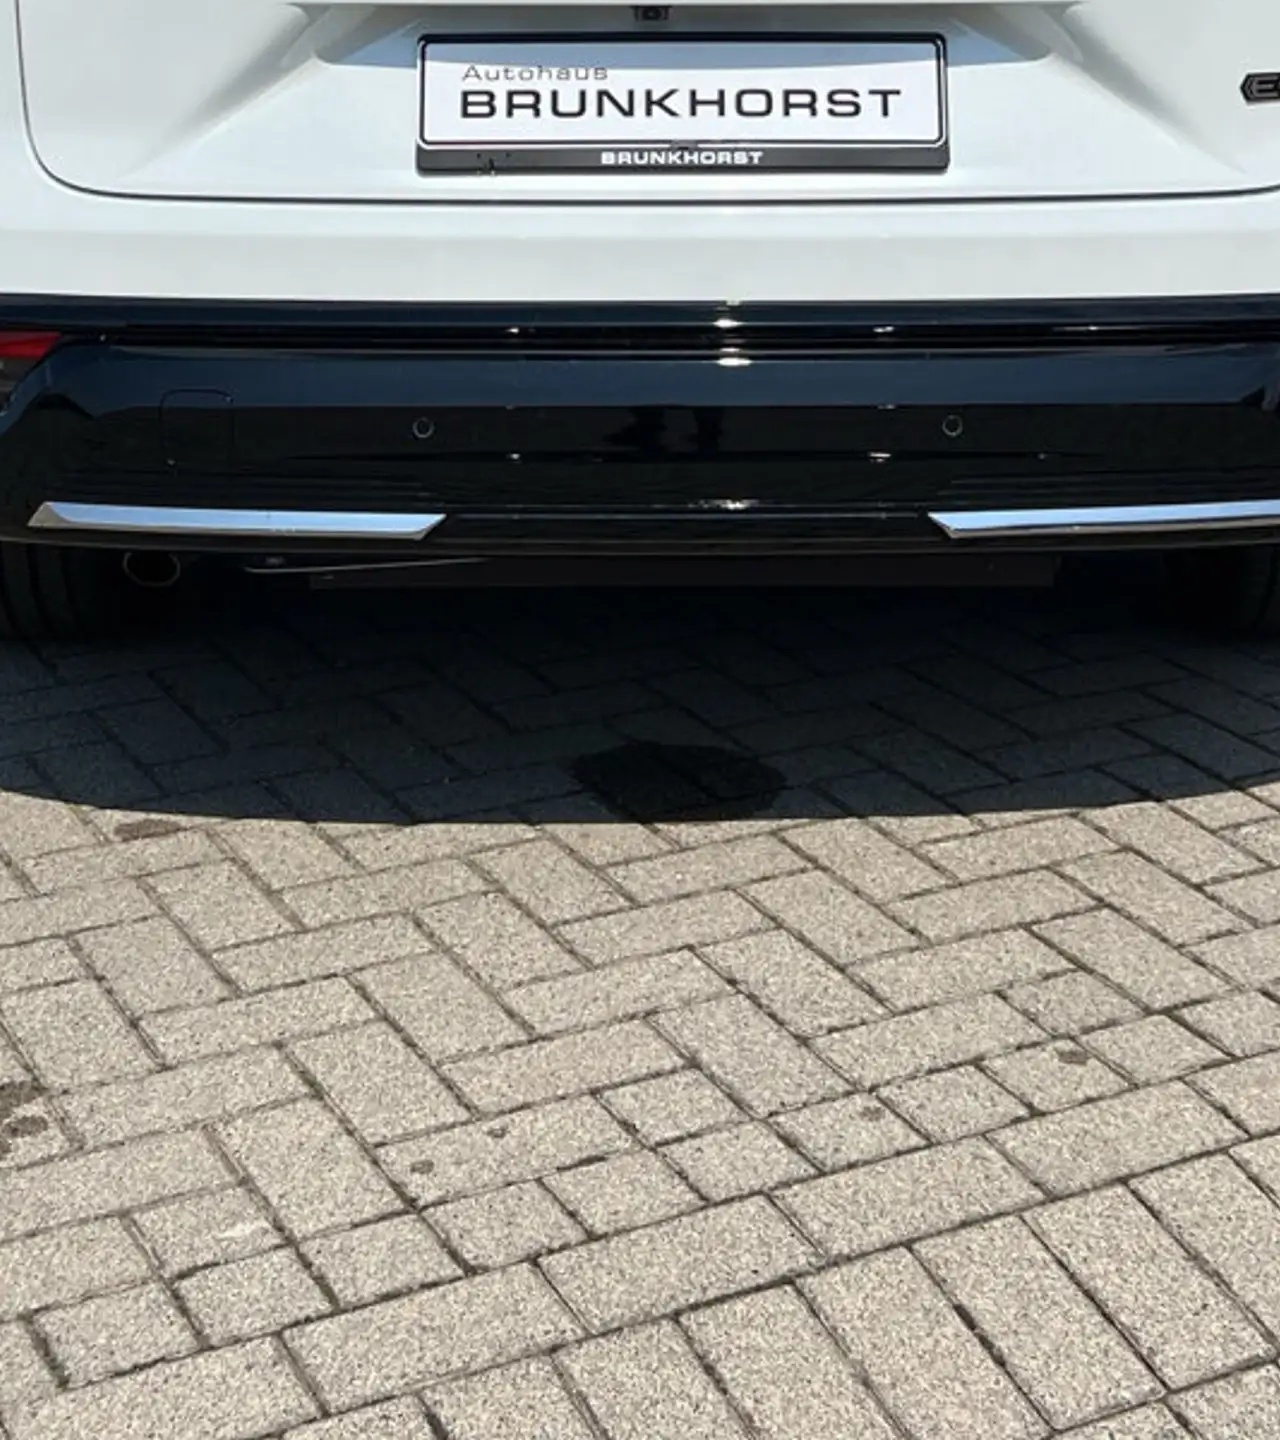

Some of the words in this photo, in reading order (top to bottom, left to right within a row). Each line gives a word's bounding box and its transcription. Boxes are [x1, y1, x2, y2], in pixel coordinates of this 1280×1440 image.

[461, 65, 609, 82] Autohaus
[460, 88, 902, 118] BRUNKHORST
[600, 150, 764, 165] BRUNKHORST
